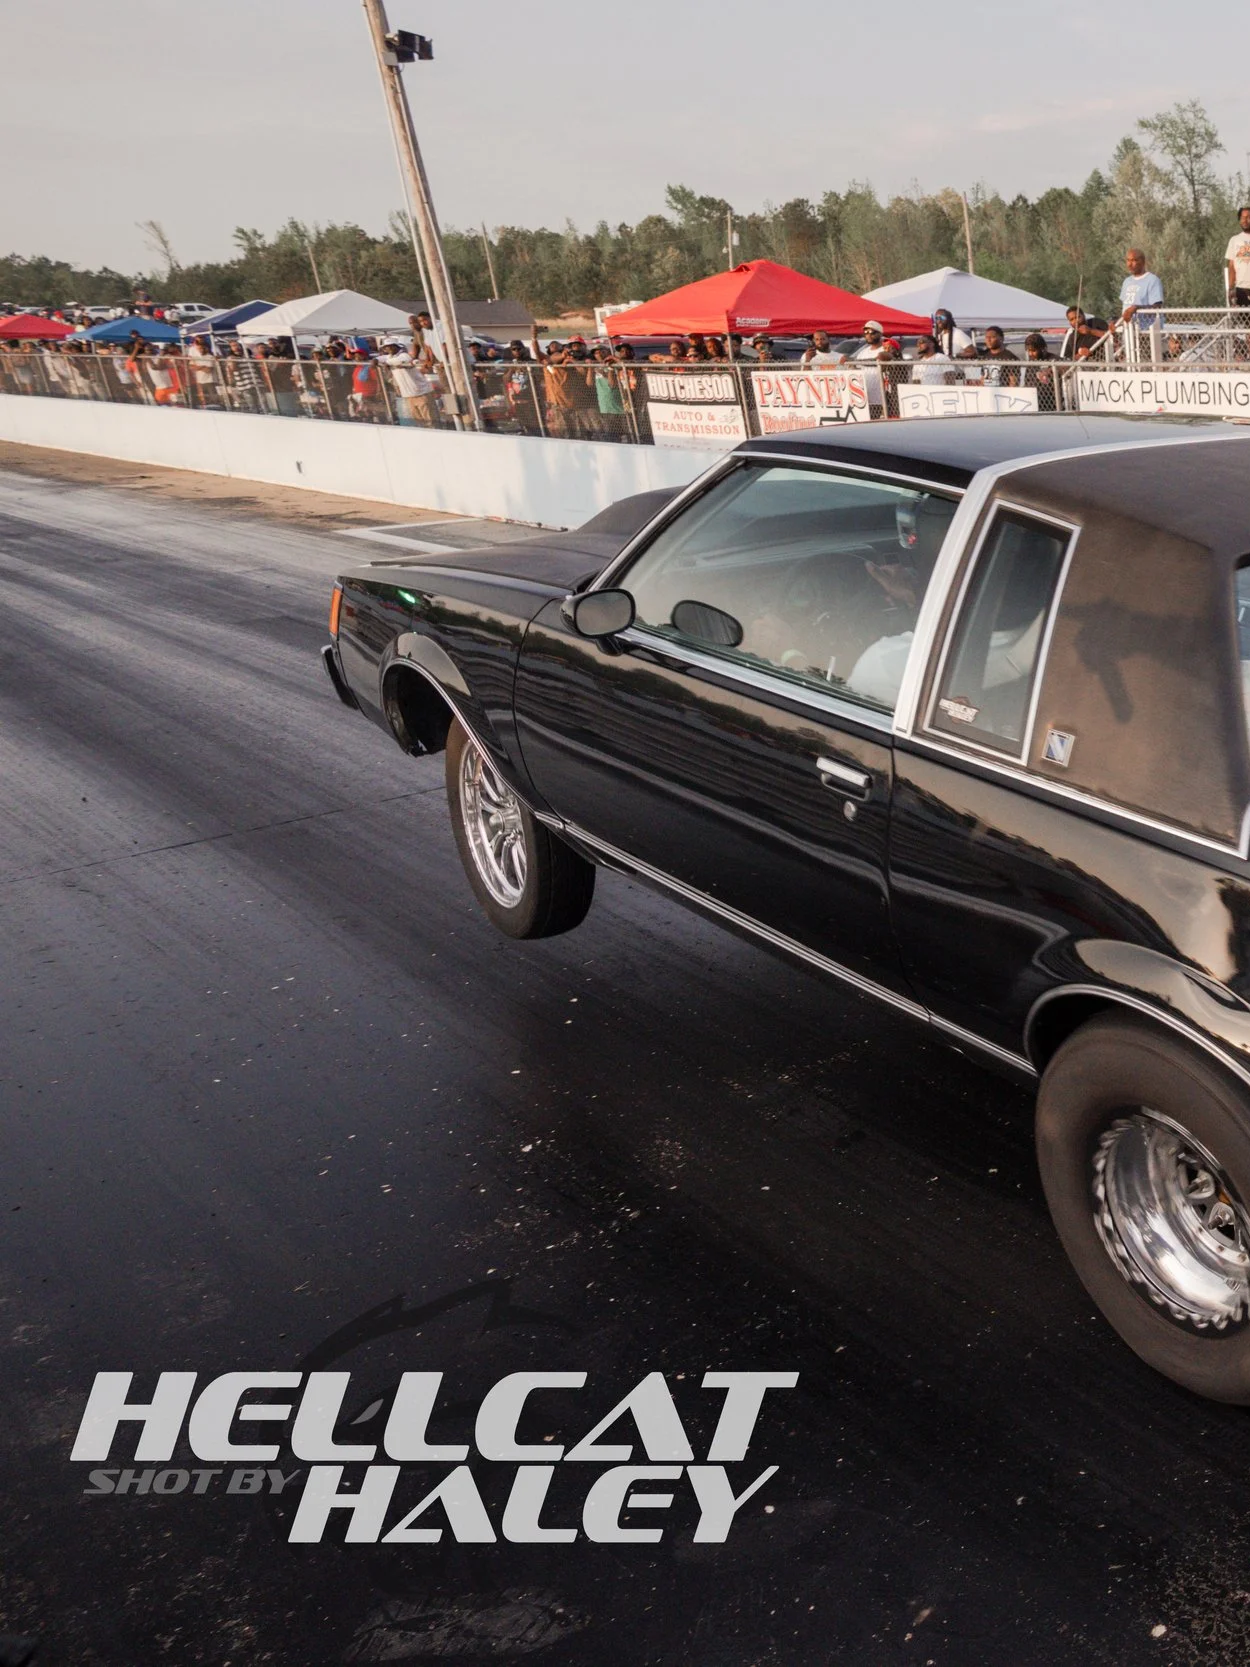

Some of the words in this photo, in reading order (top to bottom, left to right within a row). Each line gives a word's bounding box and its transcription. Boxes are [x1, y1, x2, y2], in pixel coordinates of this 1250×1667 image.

[645, 373, 737, 402] HUTCHESON
[754, 374, 868, 409] PAYNE'S
[1080, 379, 1135, 404] MACK
[1140, 380, 1250, 407] PLUMBING
[655, 421, 741, 435] TRANSMISSION
[672, 410, 703, 422] AUTO
[706, 411, 716, 422] &
